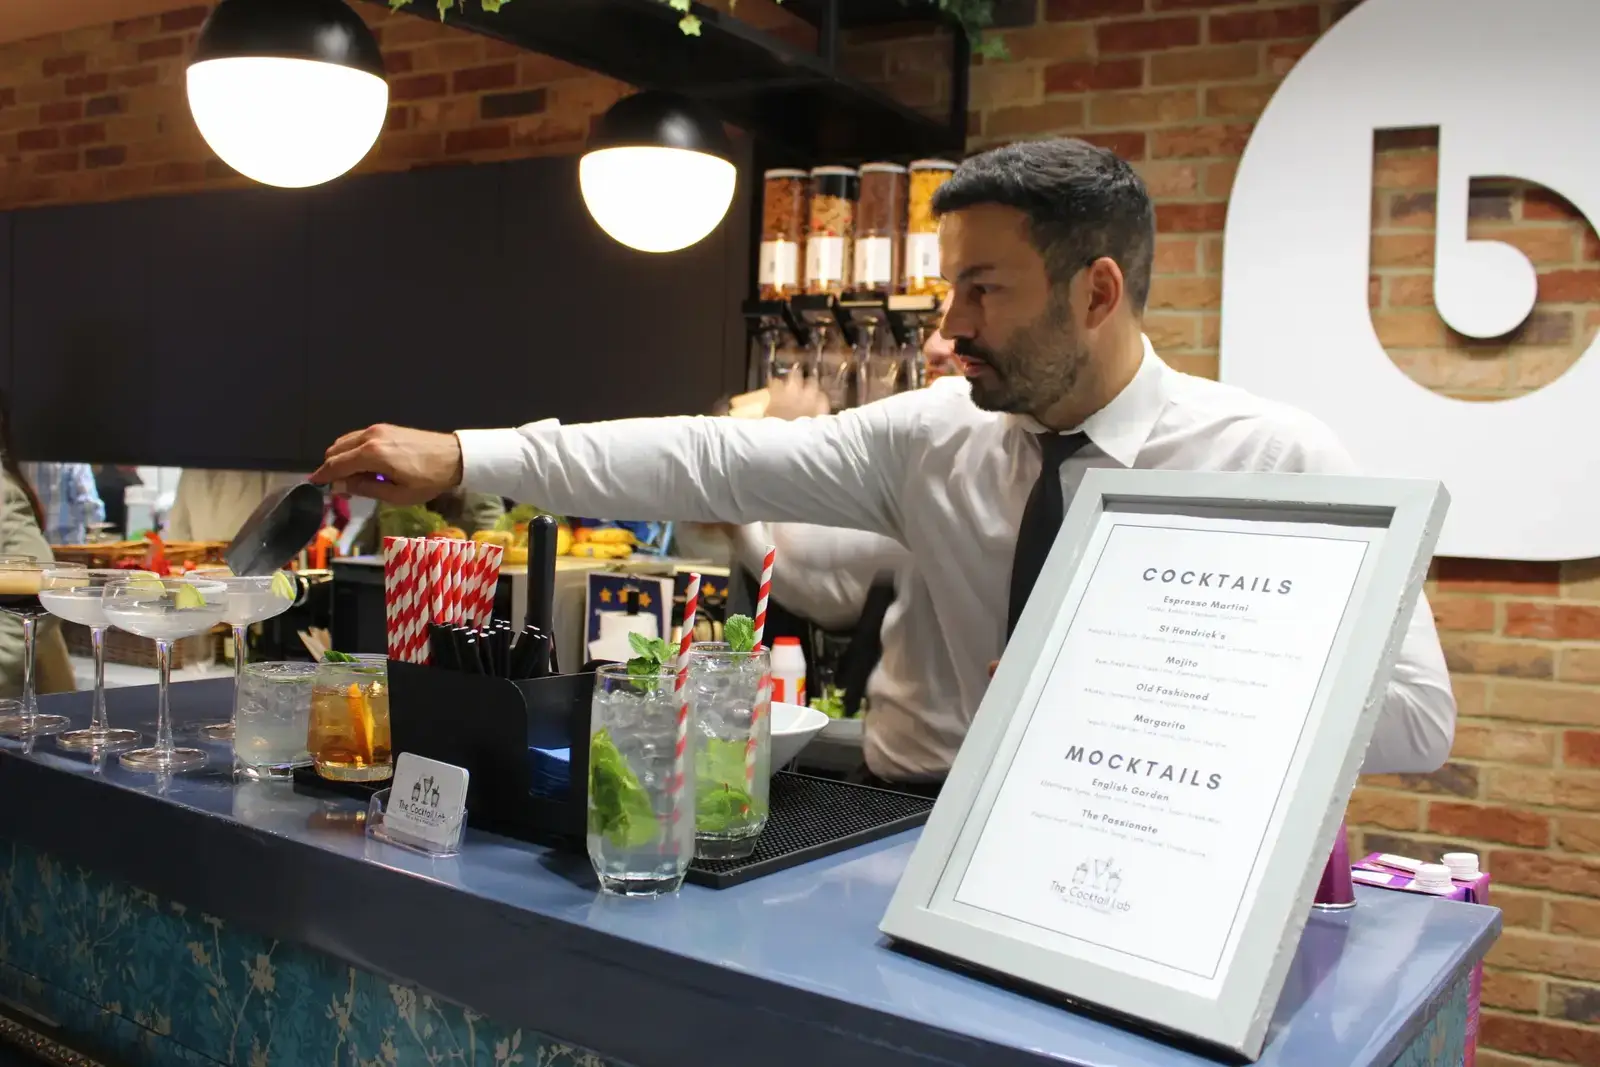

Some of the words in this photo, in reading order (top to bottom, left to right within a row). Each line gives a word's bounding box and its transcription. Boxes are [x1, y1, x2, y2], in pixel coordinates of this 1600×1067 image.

[1142, 567, 1293, 595] COCKTAILS
[1163, 596, 1207, 608] Espresso
[1210, 600, 1249, 613] Martini
[1158, 624, 1170, 634] St
[1171, 626, 1226, 641] Hendrick's
[1165, 656, 1199, 668] Mojito
[1136, 683, 1153, 693] Old
[1155, 686, 1210, 702] Fashioned
[1133, 714, 1186, 730] Margarita
[1064, 745, 1223, 791] MOCKTAILS
[1091, 778, 1128, 793] English
[1131, 786, 1169, 802] Garden
[398, 799, 409, 811] The
[410, 803, 434, 819] Cocktail
[1081, 809, 1099, 821] The
[1101, 814, 1159, 835] Passionate
[1051, 880, 1067, 894] The
[1070, 886, 1111, 906] Cocktail
[1111, 898, 1131, 913] Lab
